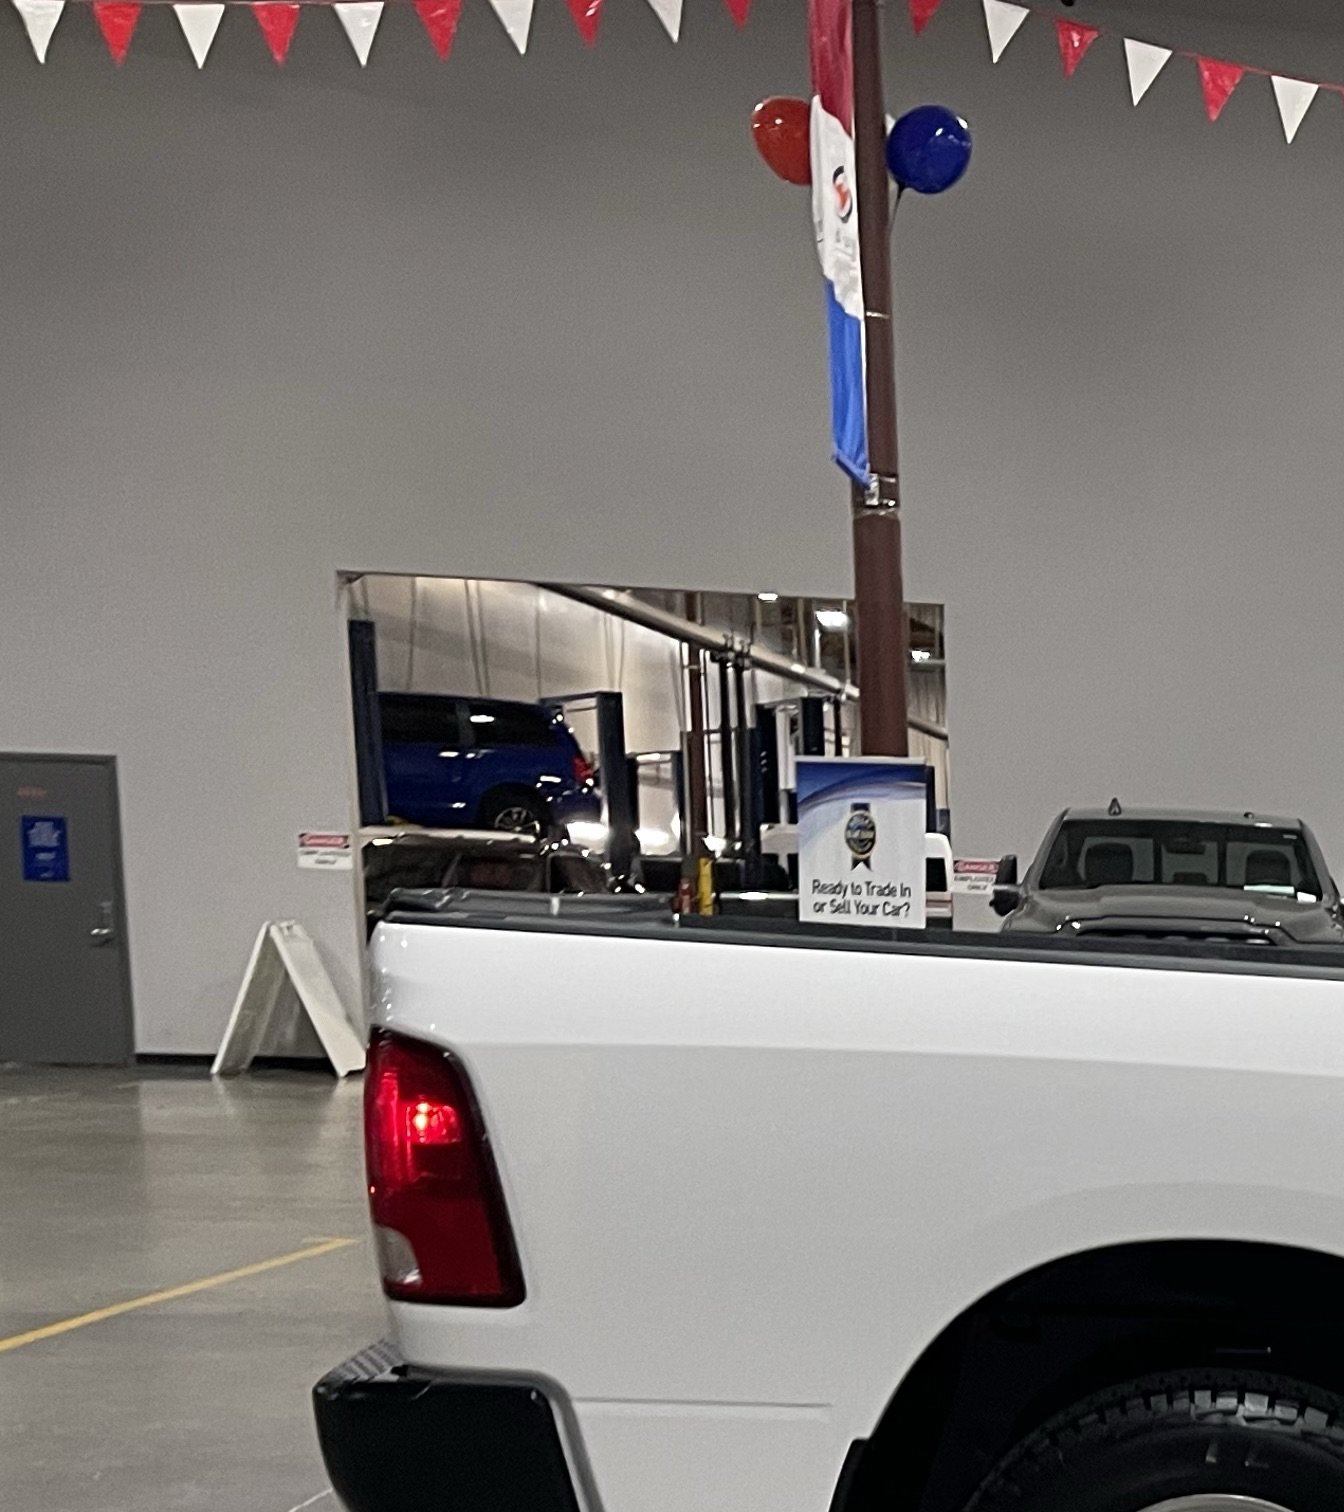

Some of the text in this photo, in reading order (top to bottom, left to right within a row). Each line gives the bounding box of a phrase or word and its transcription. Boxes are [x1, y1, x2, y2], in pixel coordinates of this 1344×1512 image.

[812, 879, 912, 898] Ready to Trade In
[813, 899, 911, 918] or Sell Your Car?
